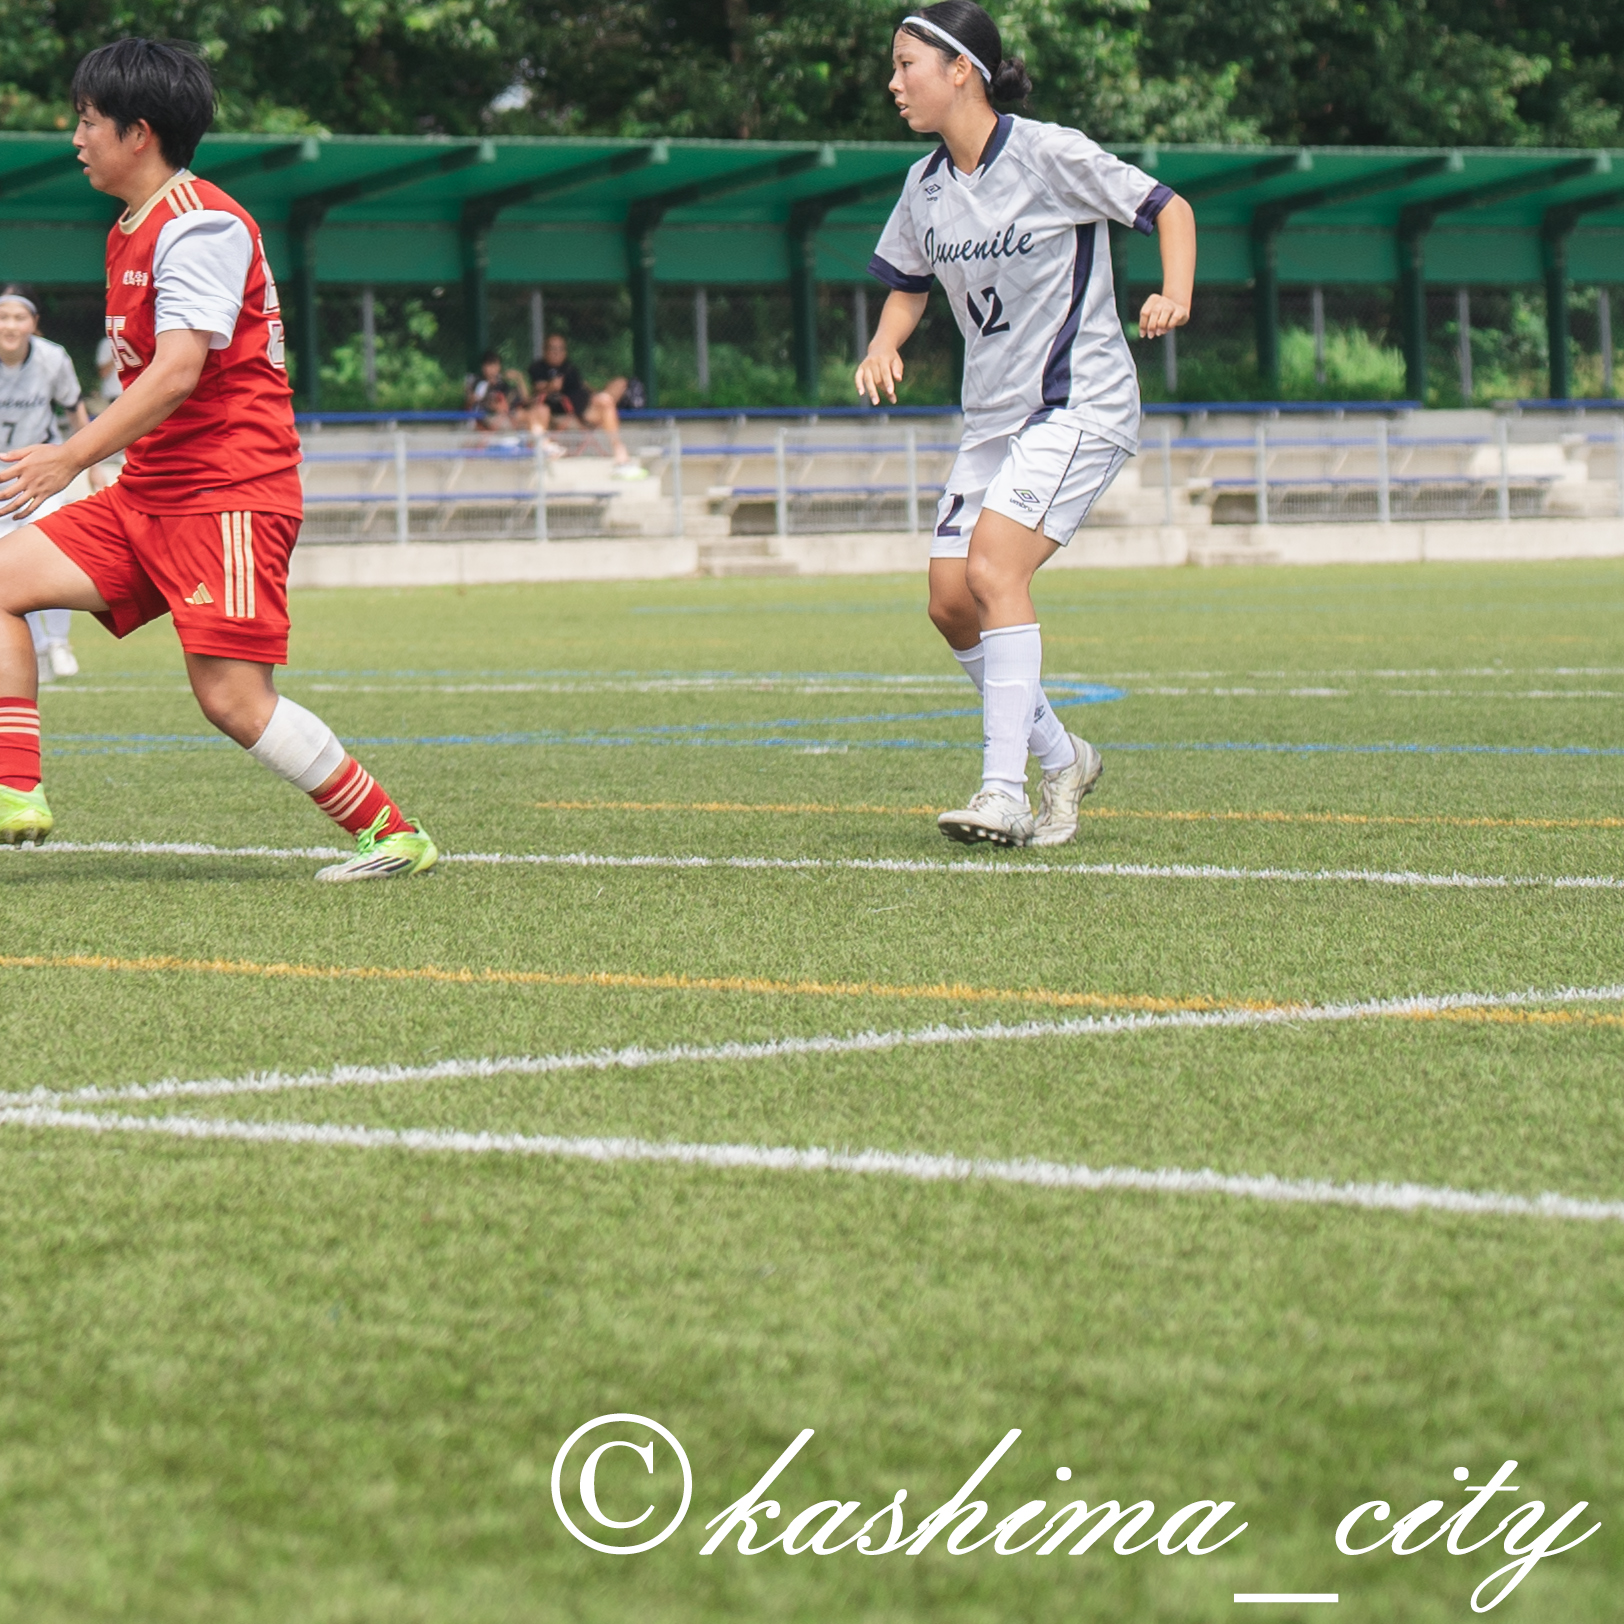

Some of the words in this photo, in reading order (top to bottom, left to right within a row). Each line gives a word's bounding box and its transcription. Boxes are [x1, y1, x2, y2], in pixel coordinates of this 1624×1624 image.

[925, 222, 1035, 268] Juvenile
[967, 286, 1010, 337] 12
[3, 422, 17, 445] 7
